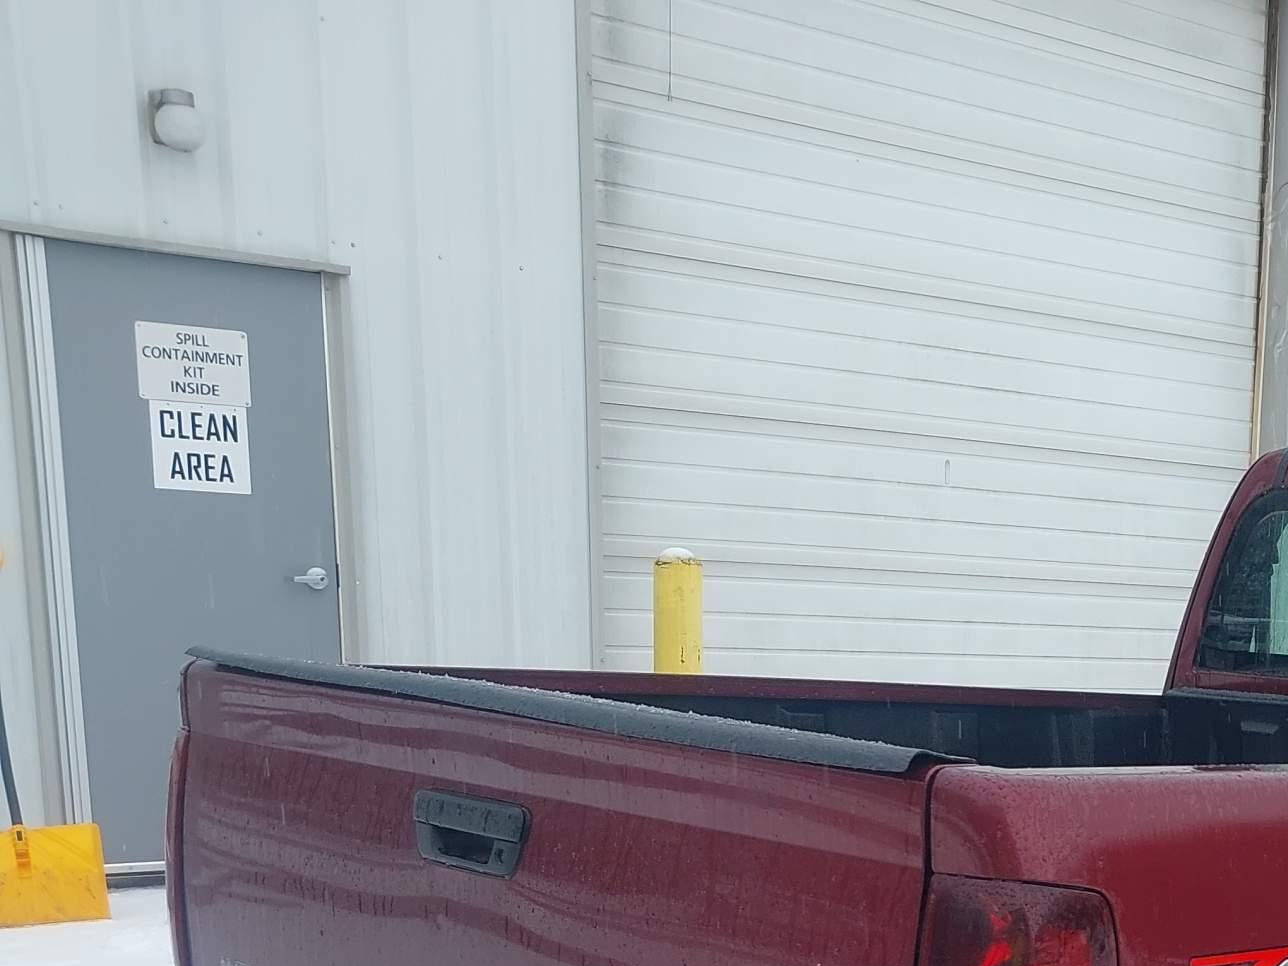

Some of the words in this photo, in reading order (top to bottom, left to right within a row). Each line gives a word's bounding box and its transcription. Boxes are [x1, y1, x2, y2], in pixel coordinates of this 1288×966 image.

[175, 332, 210, 348] SPILL
[141, 345, 244, 367] CONTAINMENT
[183, 365, 206, 379] KIT
[170, 380, 221, 397] INSIDE
[159, 409, 240, 444] CLEAN
[170, 451, 235, 483] AREA
